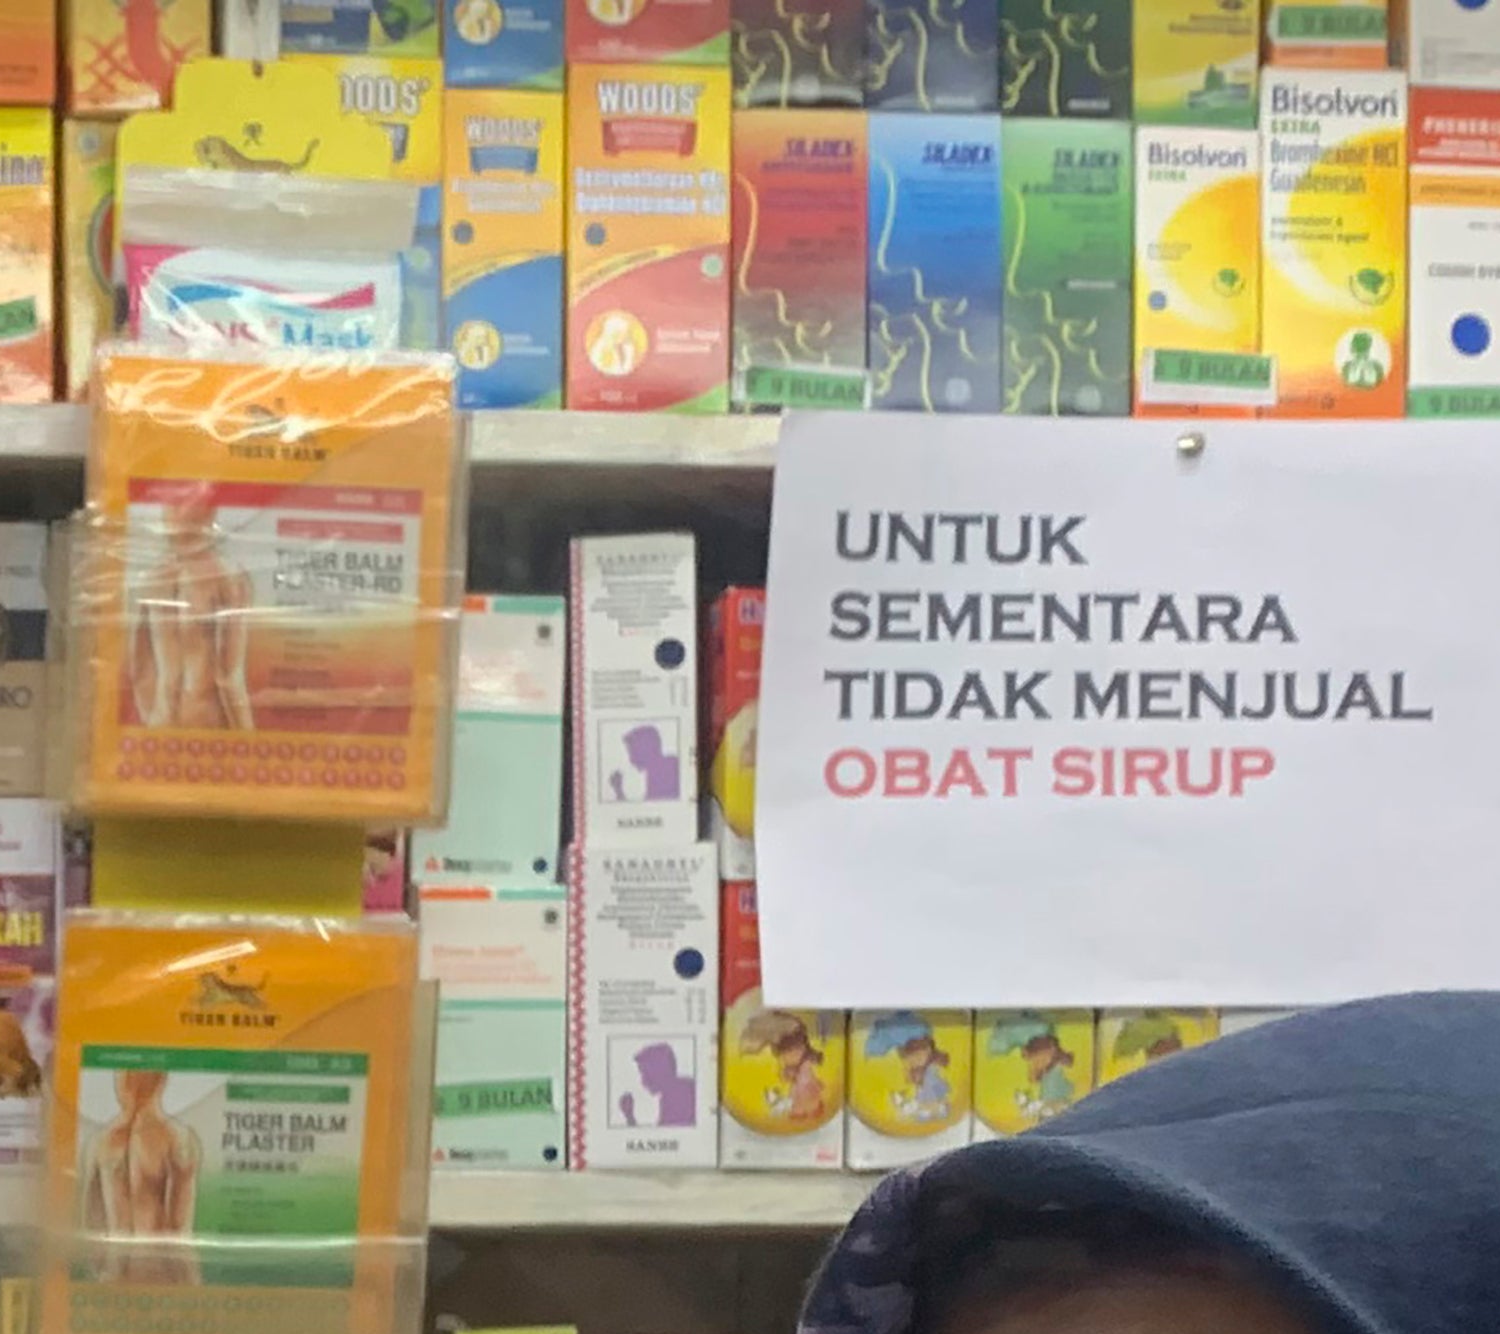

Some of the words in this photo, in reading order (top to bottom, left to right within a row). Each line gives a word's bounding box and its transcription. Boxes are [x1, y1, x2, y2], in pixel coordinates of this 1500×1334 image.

[1270, 85, 1398, 119] Bisolvon
[835, 512, 1088, 566] UNTUK
[340, 552, 404, 572] BALM
[828, 592, 1298, 643] SEMENTARA
[823, 670, 1053, 722] TIDAK
[1072, 671, 1434, 722] MENJUAL
[823, 747, 1034, 799] OBAT
[1051, 747, 1277, 797] SIRUP
[221, 1133, 316, 1154] PLASTER
[222, 1113, 282, 1133] TIGER
[286, 1113, 349, 1132] BALM
